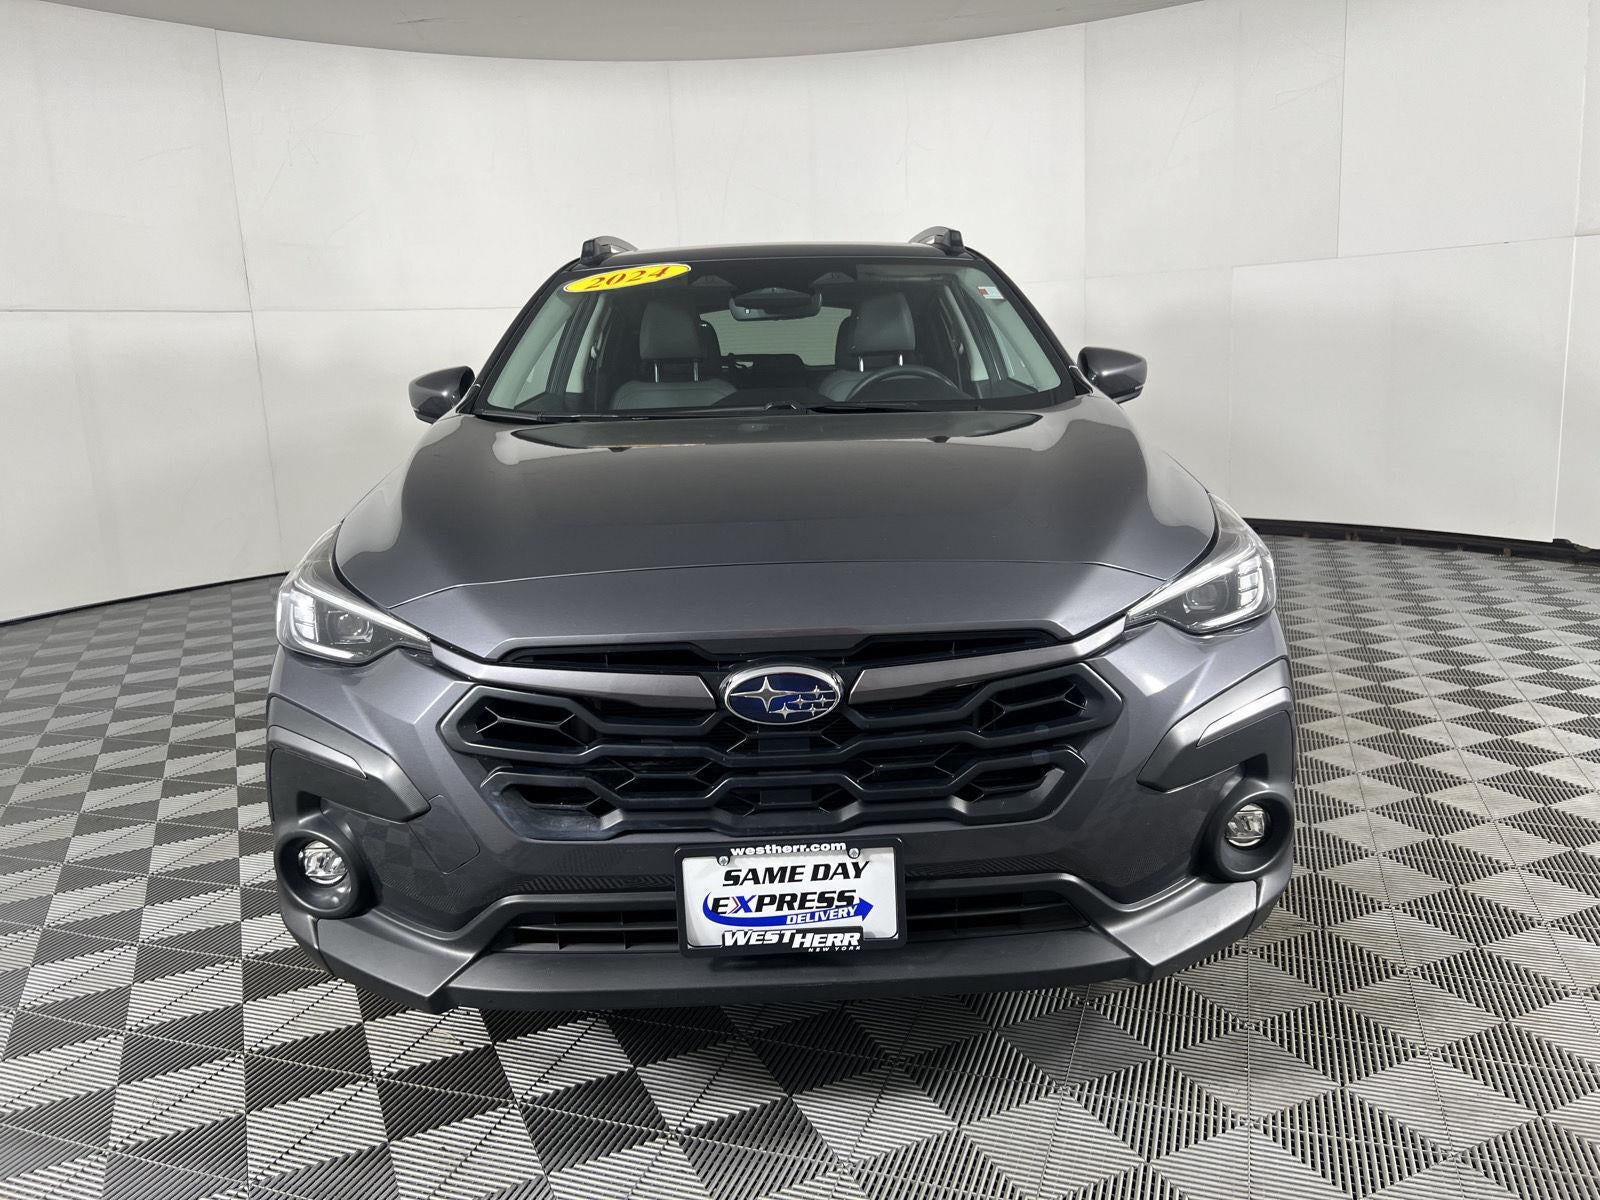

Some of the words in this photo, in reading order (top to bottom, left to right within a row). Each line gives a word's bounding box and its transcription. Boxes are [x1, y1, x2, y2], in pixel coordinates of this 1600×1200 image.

[585, 266, 670, 290] 2024
[730, 842, 846, 856] westherr.com
[722, 865, 805, 887] SAME
[810, 860, 869, 882] DAY
[711, 889, 857, 914] EXPRESS
[785, 905, 858, 925] DELIVERY
